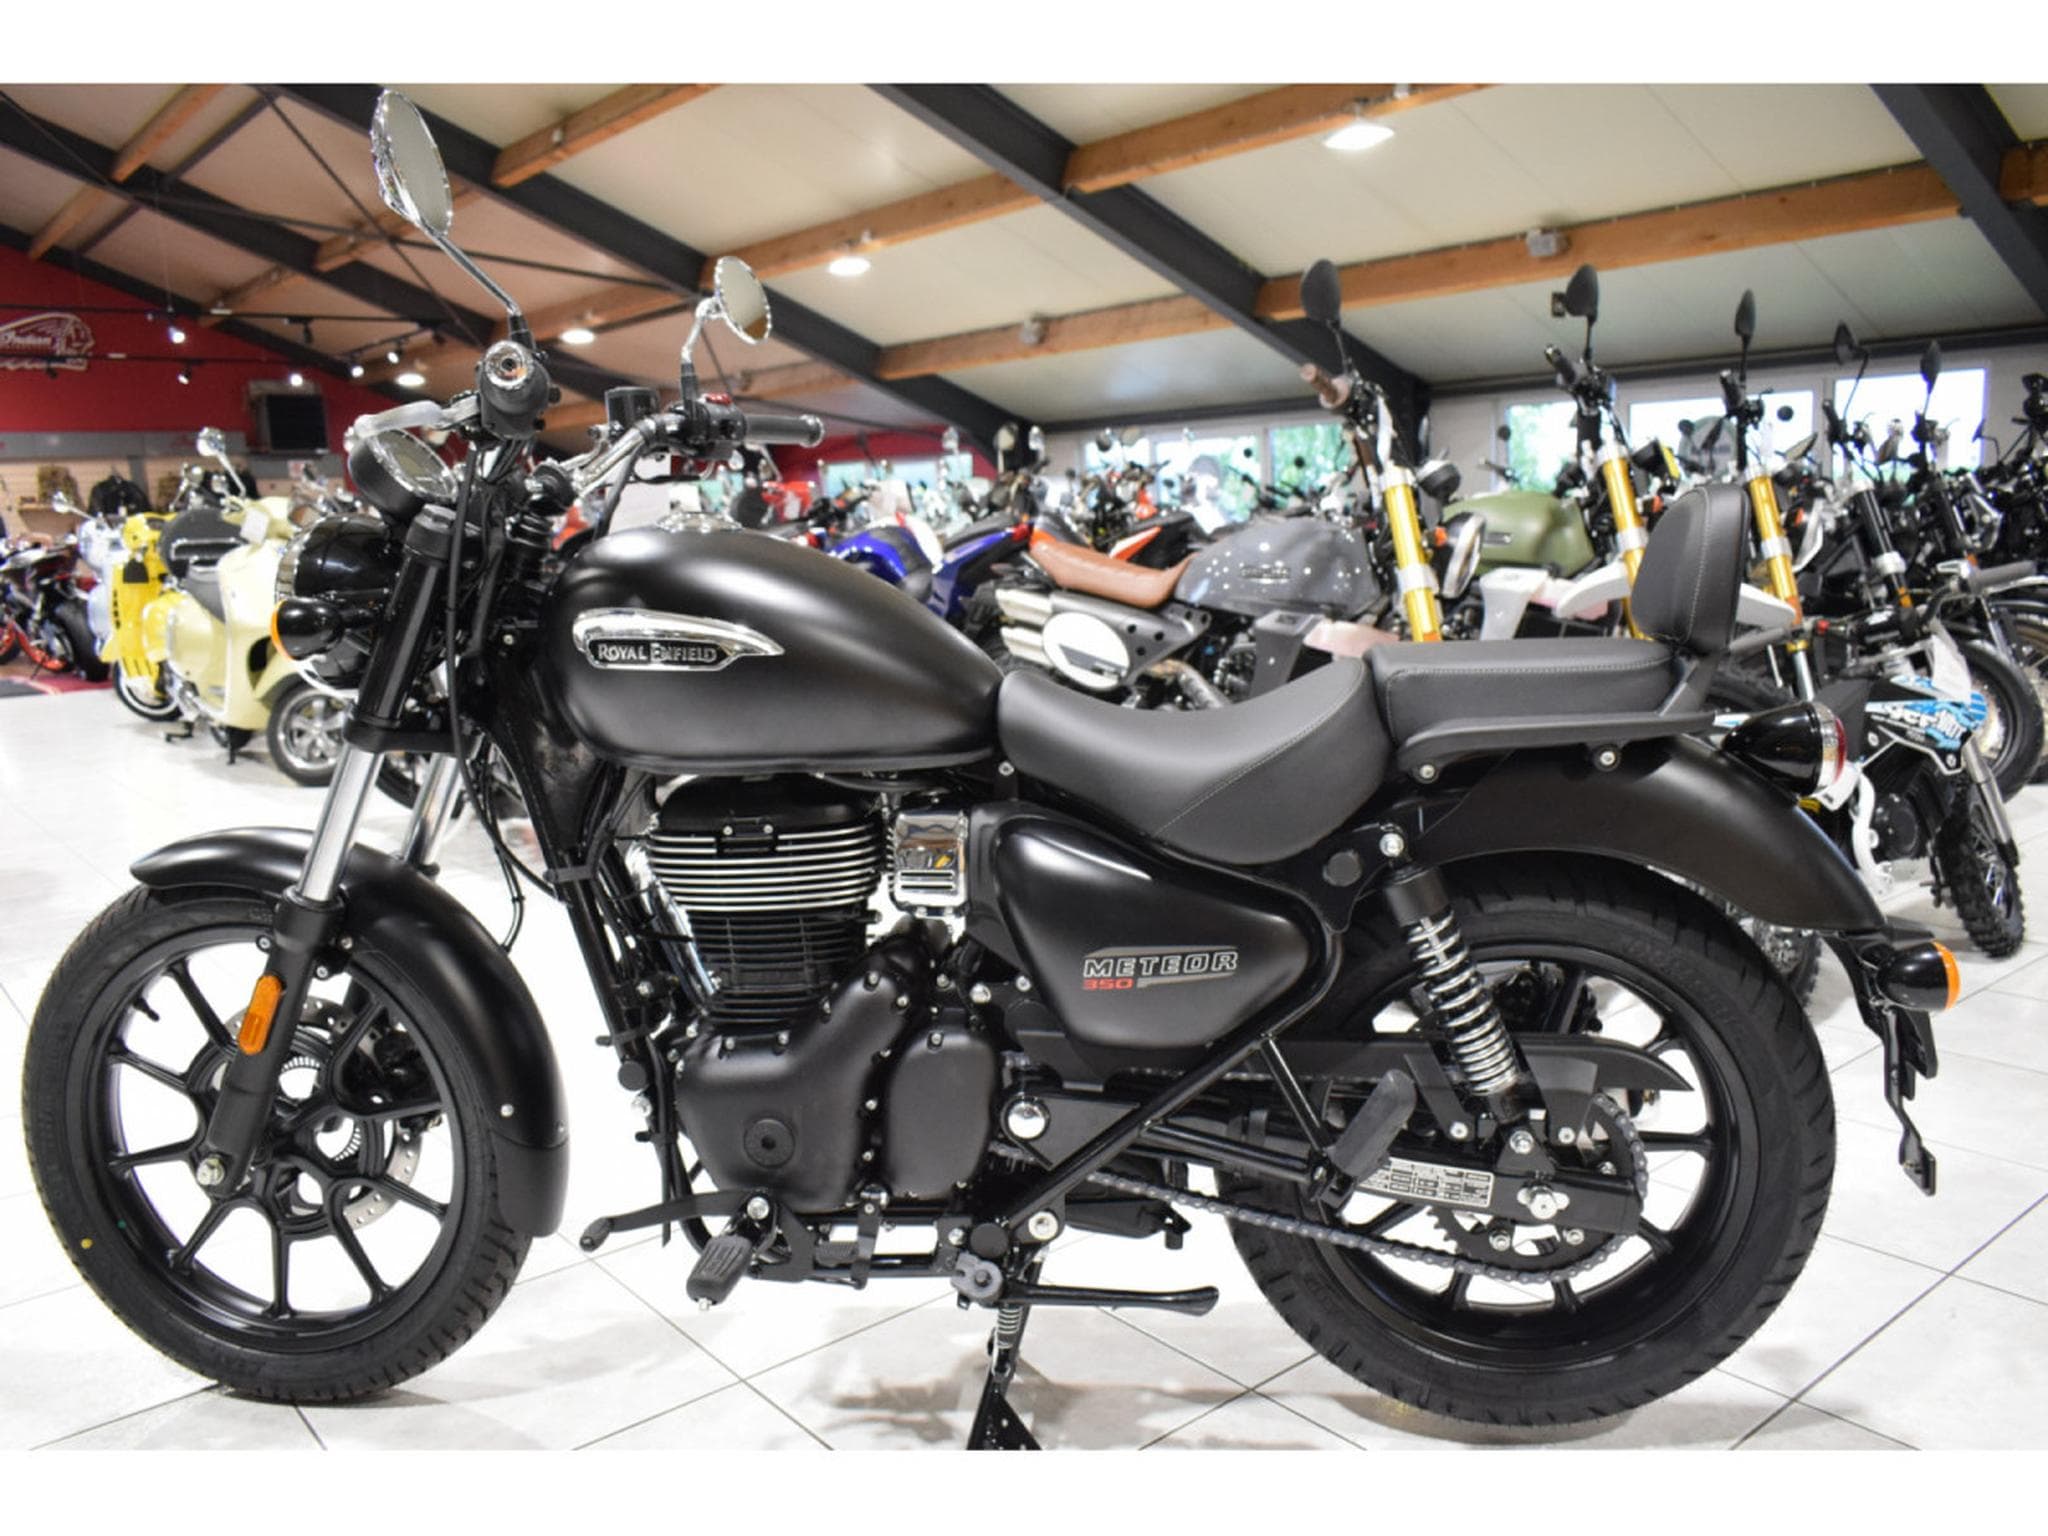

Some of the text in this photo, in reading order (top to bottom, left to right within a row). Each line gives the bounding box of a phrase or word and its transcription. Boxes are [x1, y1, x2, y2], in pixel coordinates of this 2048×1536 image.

[598, 643, 717, 663] ROYAL ENFIELD
[1083, 951, 1238, 978] METEOR
[1083, 977, 1134, 990] 350
